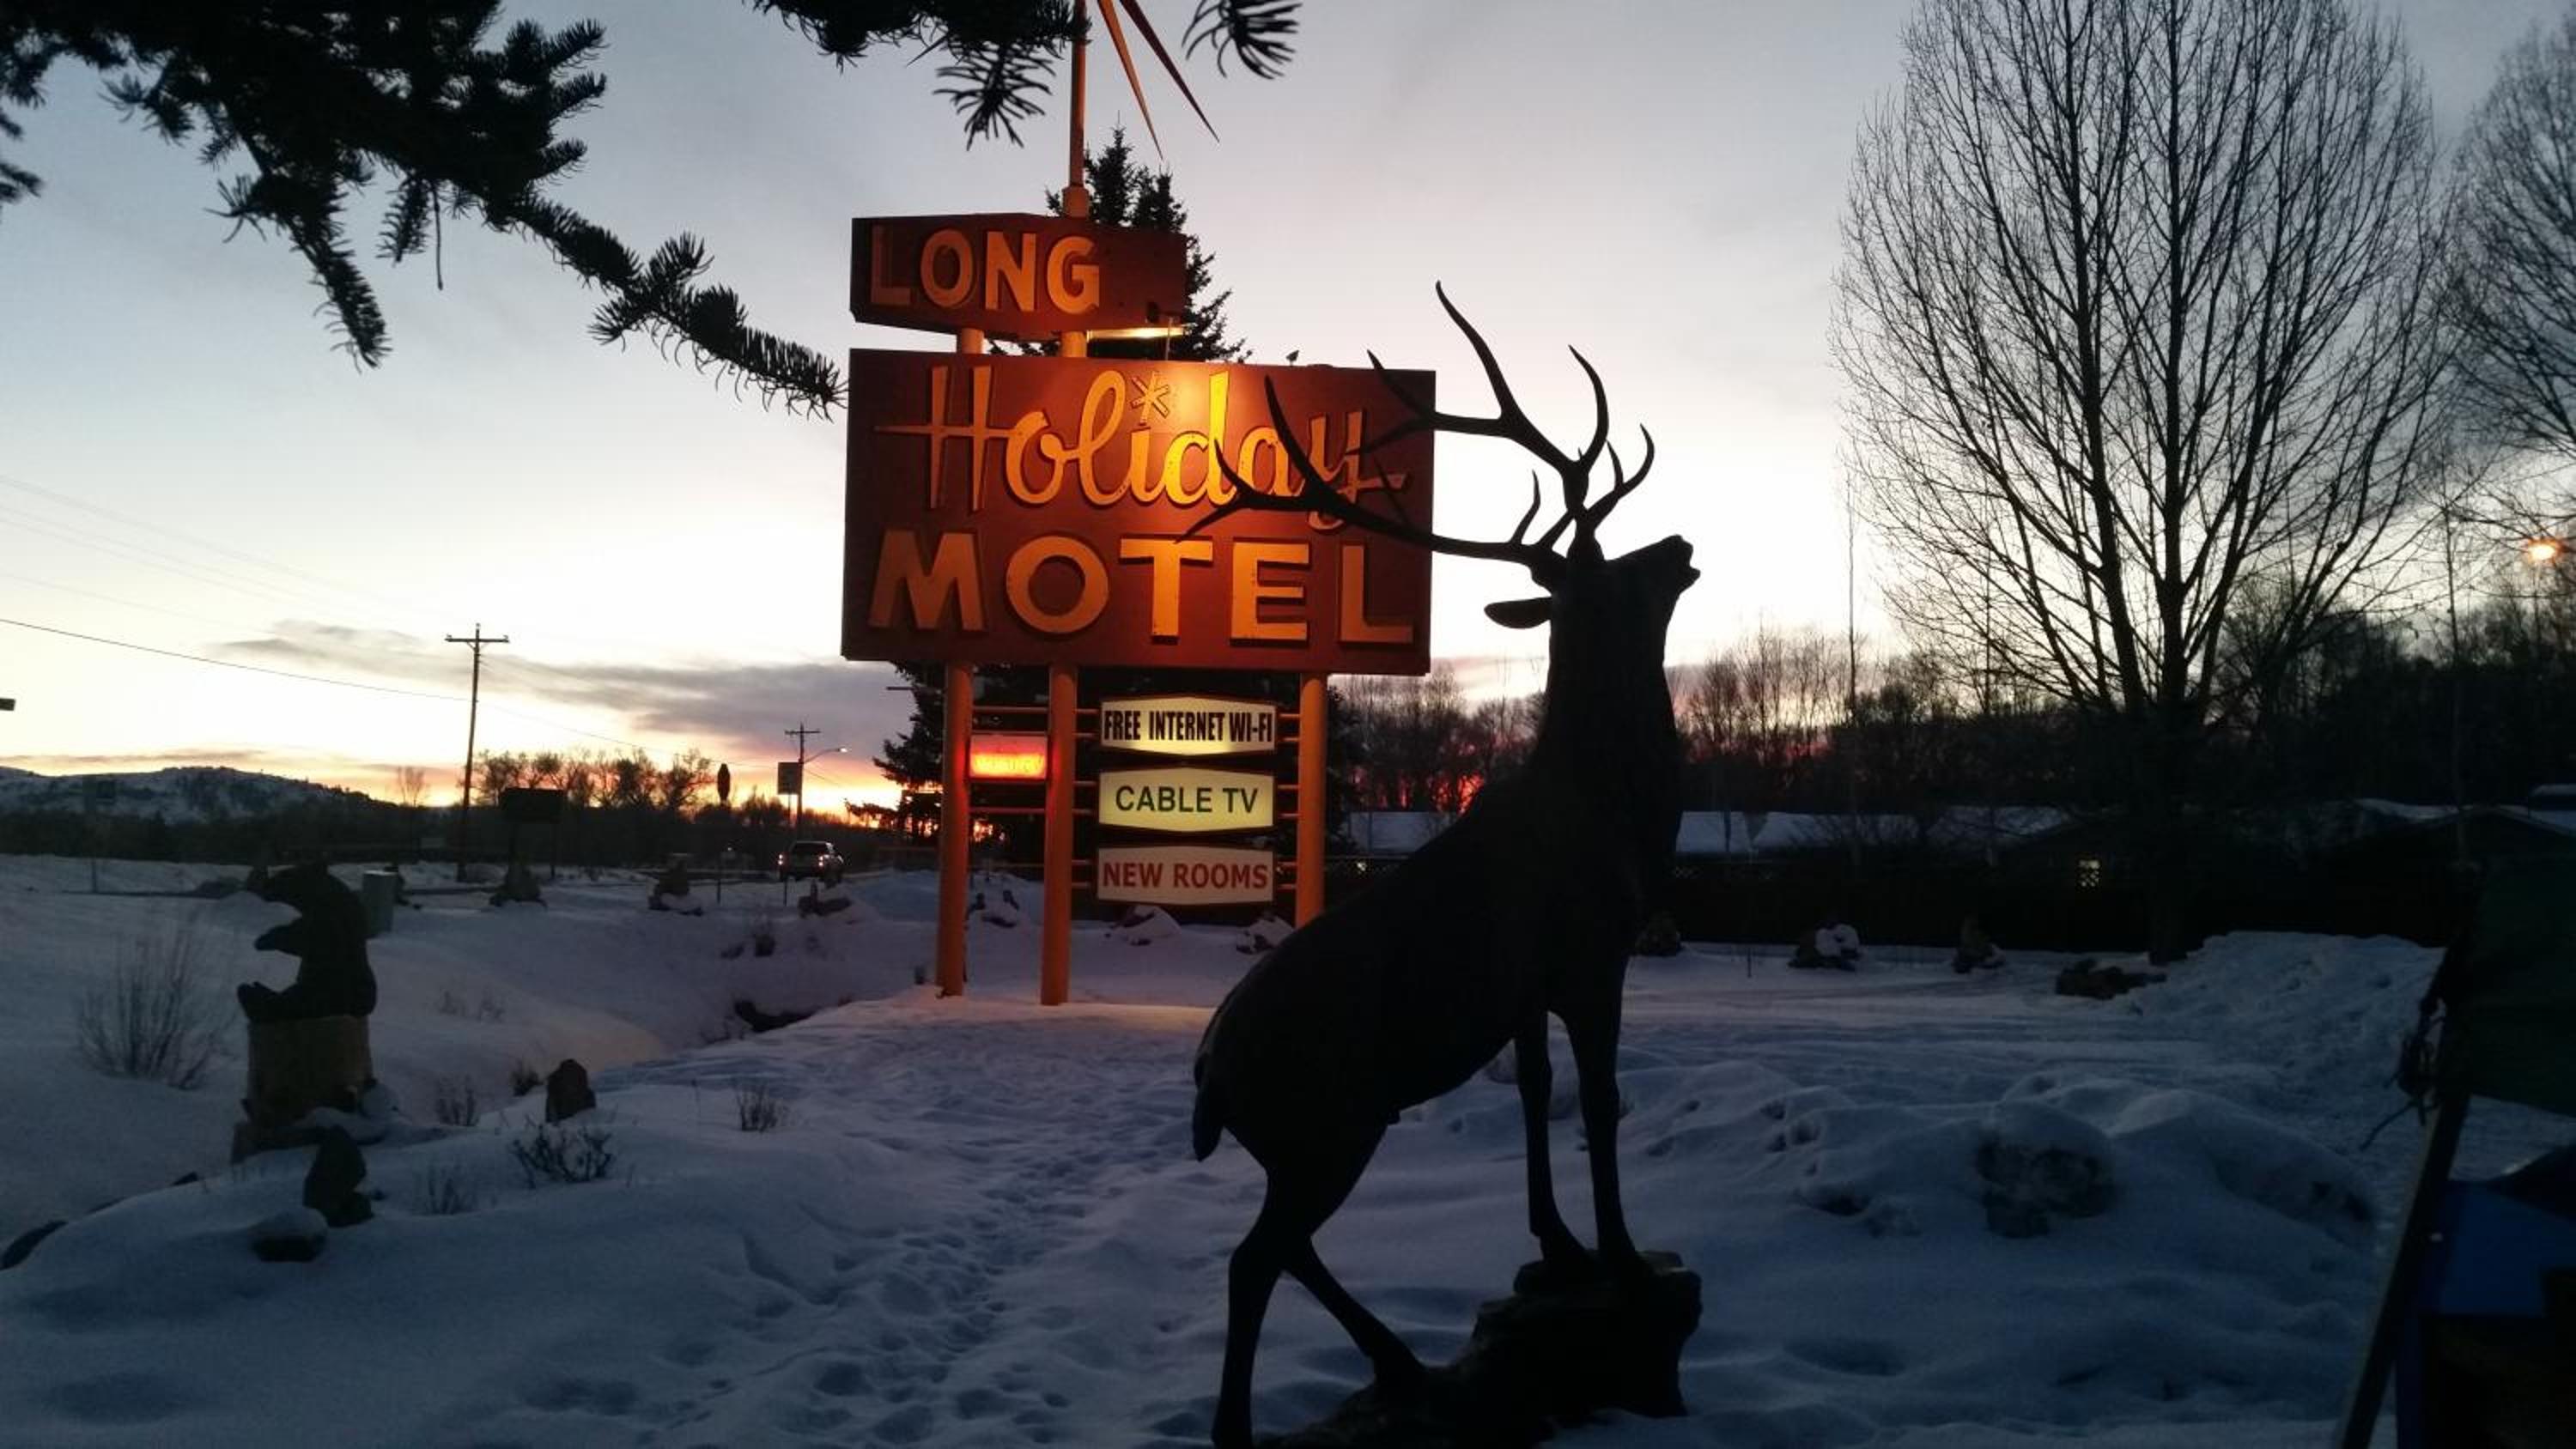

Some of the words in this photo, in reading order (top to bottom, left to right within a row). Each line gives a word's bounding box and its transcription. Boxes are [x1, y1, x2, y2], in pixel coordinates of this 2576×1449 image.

[869, 224, 1101, 315] LONG
[873, 364, 1415, 532] Holiday
[867, 528, 1416, 647] MOTEL
[1104, 710, 1141, 741] FREE
[1149, 711, 1225, 742] INTERNET
[1229, 712, 1273, 743] WI-FI
[1115, 785, 1212, 813] CABLE
[1223, 787, 1259, 814] TV
[1103, 864, 1162, 888] NEW
[1173, 864, 1268, 889] ROOMS
